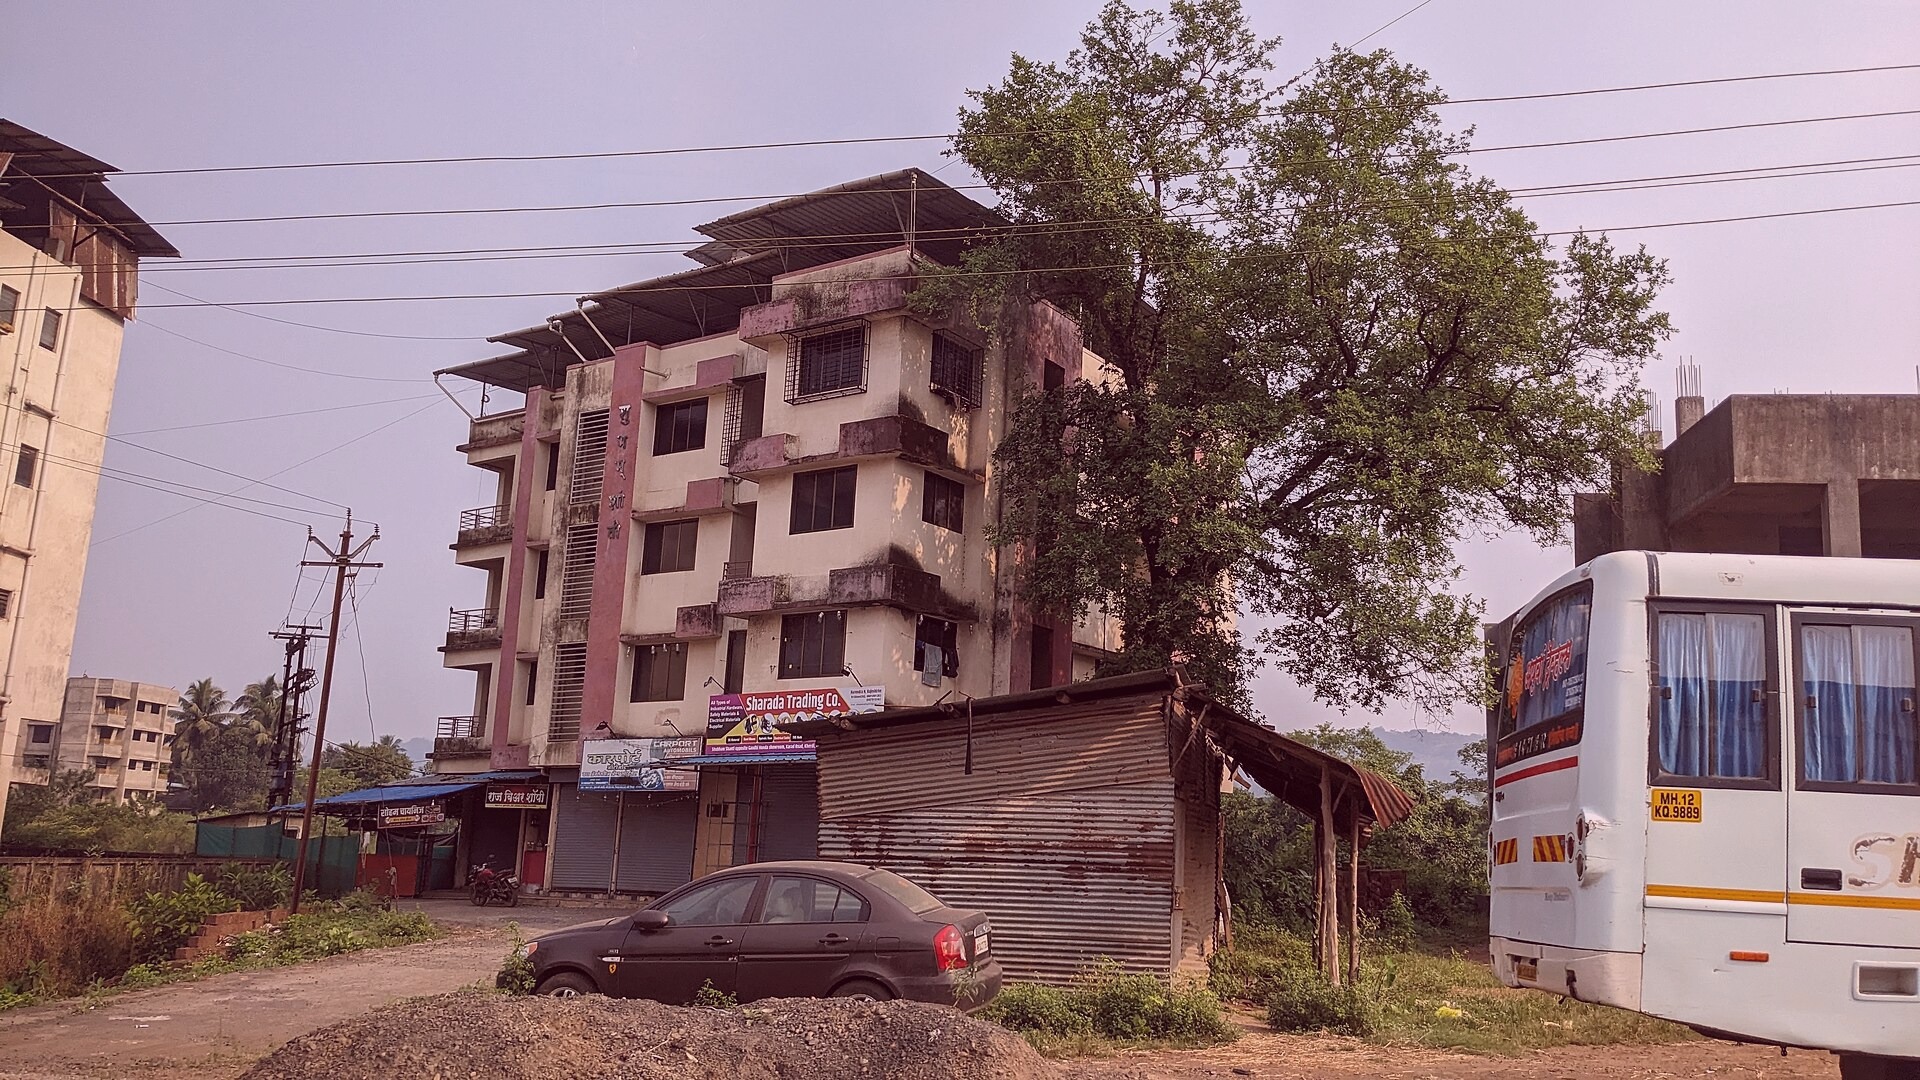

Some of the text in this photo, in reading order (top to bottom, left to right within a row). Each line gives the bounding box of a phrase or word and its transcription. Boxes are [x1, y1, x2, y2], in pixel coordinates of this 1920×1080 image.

[746, 694, 785, 711] Sharada
[786, 692, 825, 710] Trading
[826, 692, 841, 707] Co.
[653, 740, 698, 748] CARPORT
[587, 748, 642, 765] कारपोर्ट
[488, 791, 503, 802] राज
[1660, 793, 1695, 805] MH.12
[1654, 806, 1700, 819] KQ.9889
